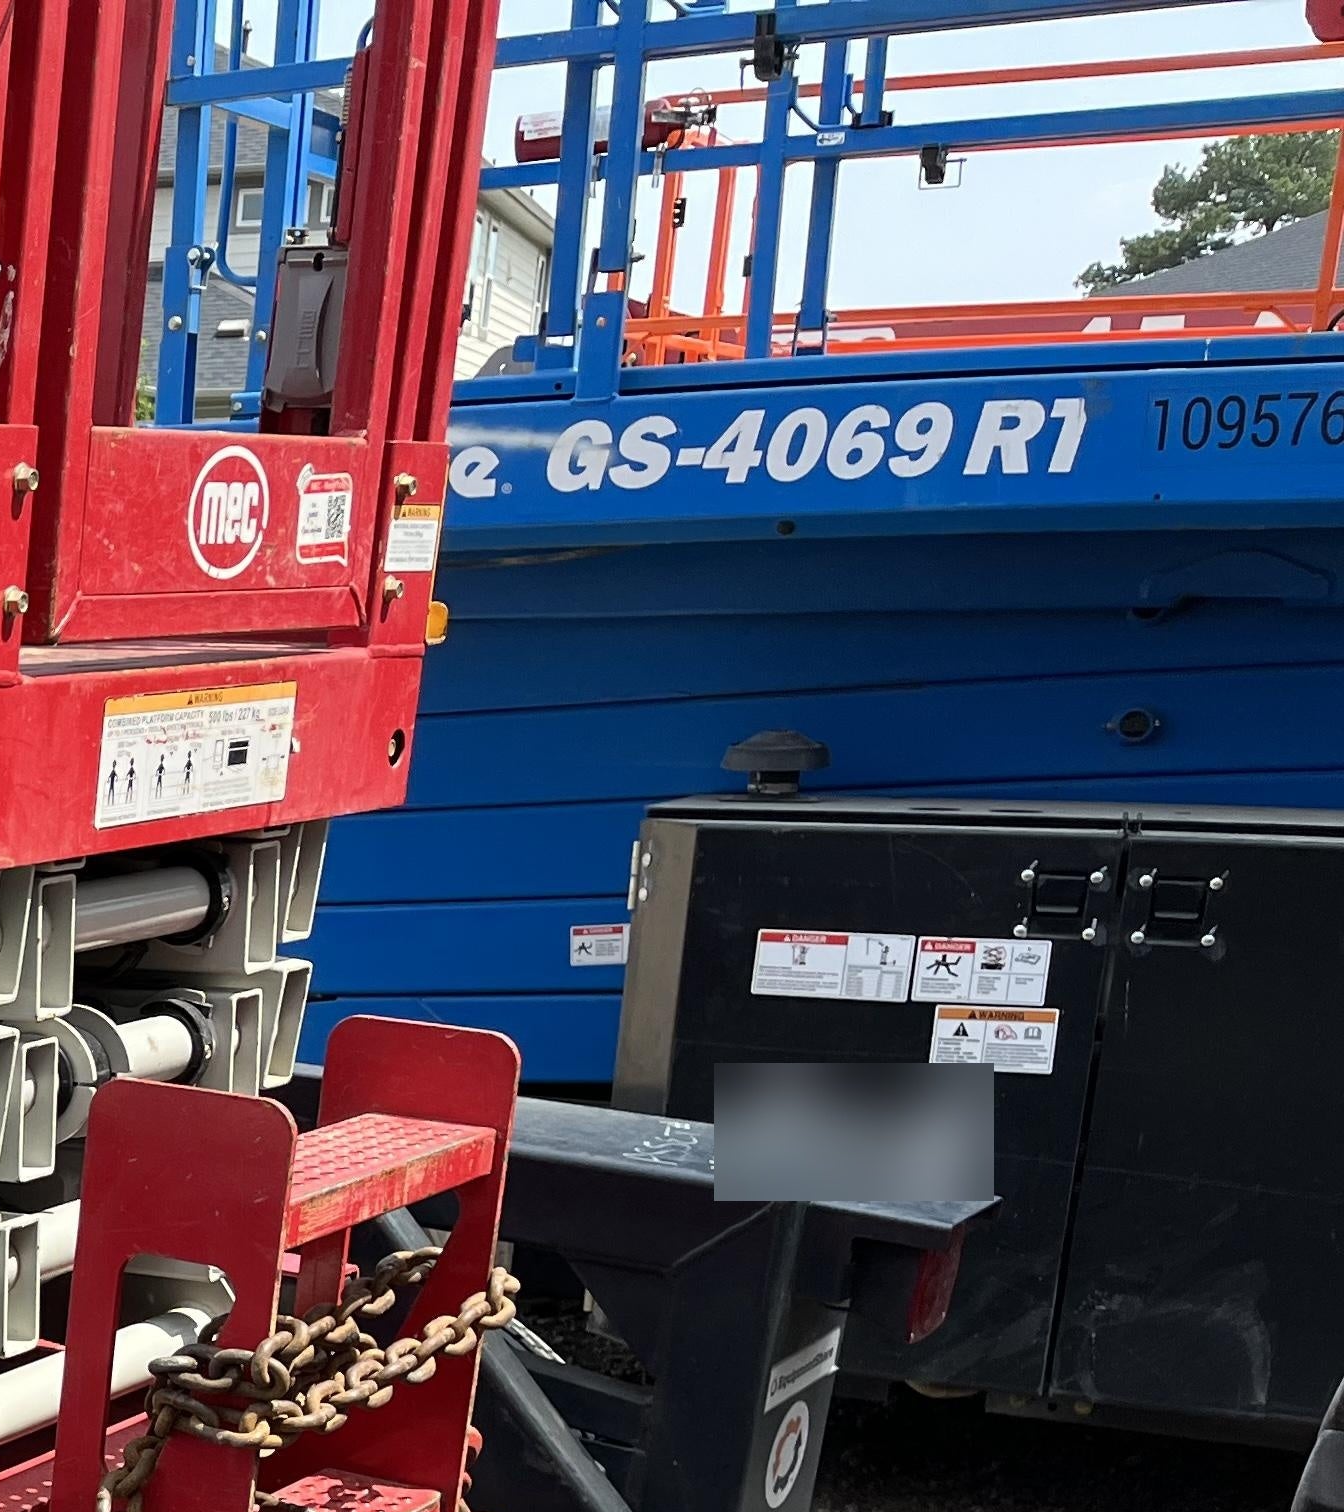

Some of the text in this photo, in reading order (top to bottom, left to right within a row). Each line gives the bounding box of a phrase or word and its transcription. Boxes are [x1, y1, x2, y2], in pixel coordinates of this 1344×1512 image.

[546, 405, 954, 492] GS-4069
[193, 691, 223, 704] WARNING
[791, 934, 827, 944] DANGER
[934, 940, 972, 951] DANGER
[978, 1010, 1024, 1021] WARNING
